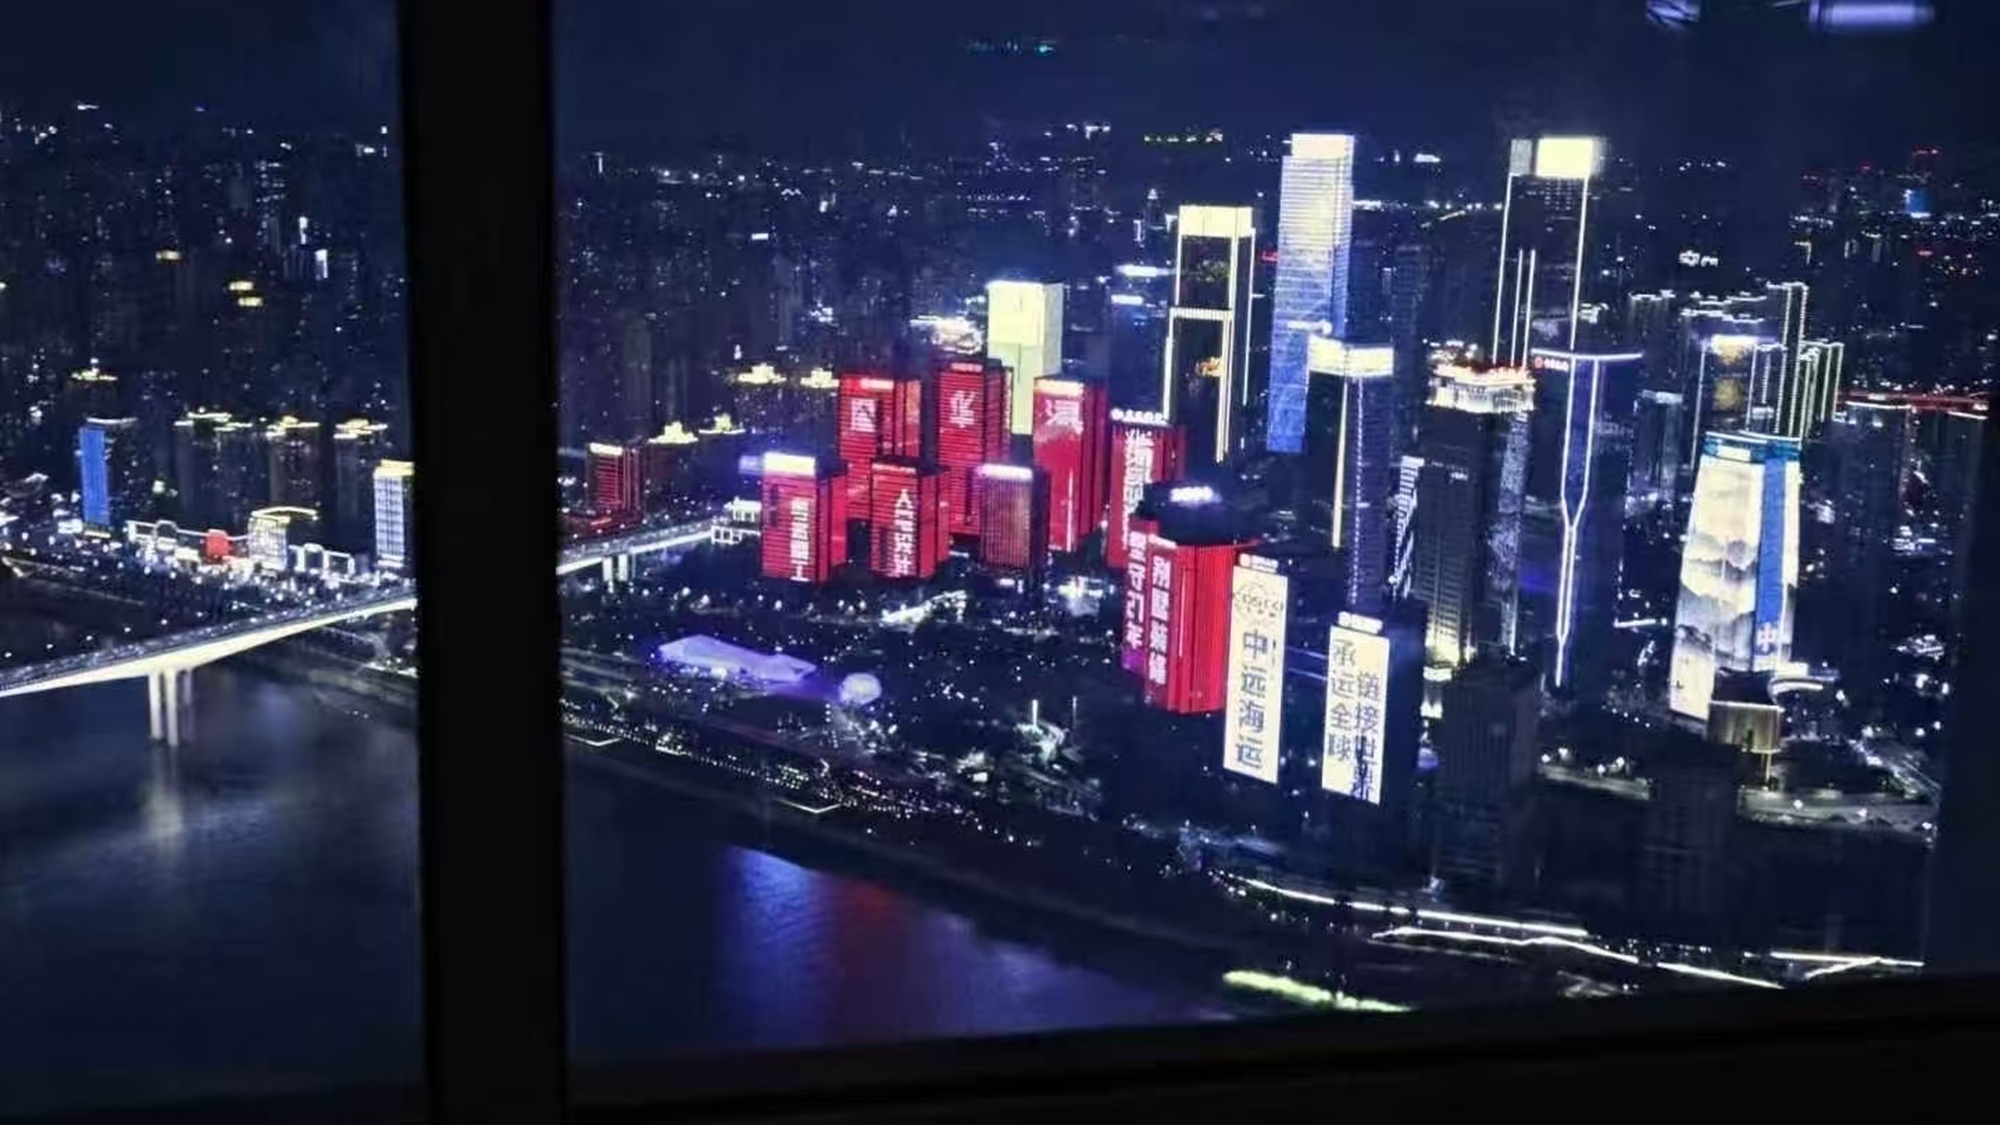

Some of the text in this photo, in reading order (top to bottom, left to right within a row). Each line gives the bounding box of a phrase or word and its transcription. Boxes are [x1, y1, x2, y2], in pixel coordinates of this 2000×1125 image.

[1235, 628, 1268, 769] 中远海运
[1328, 638, 1356, 763] 承运全球
